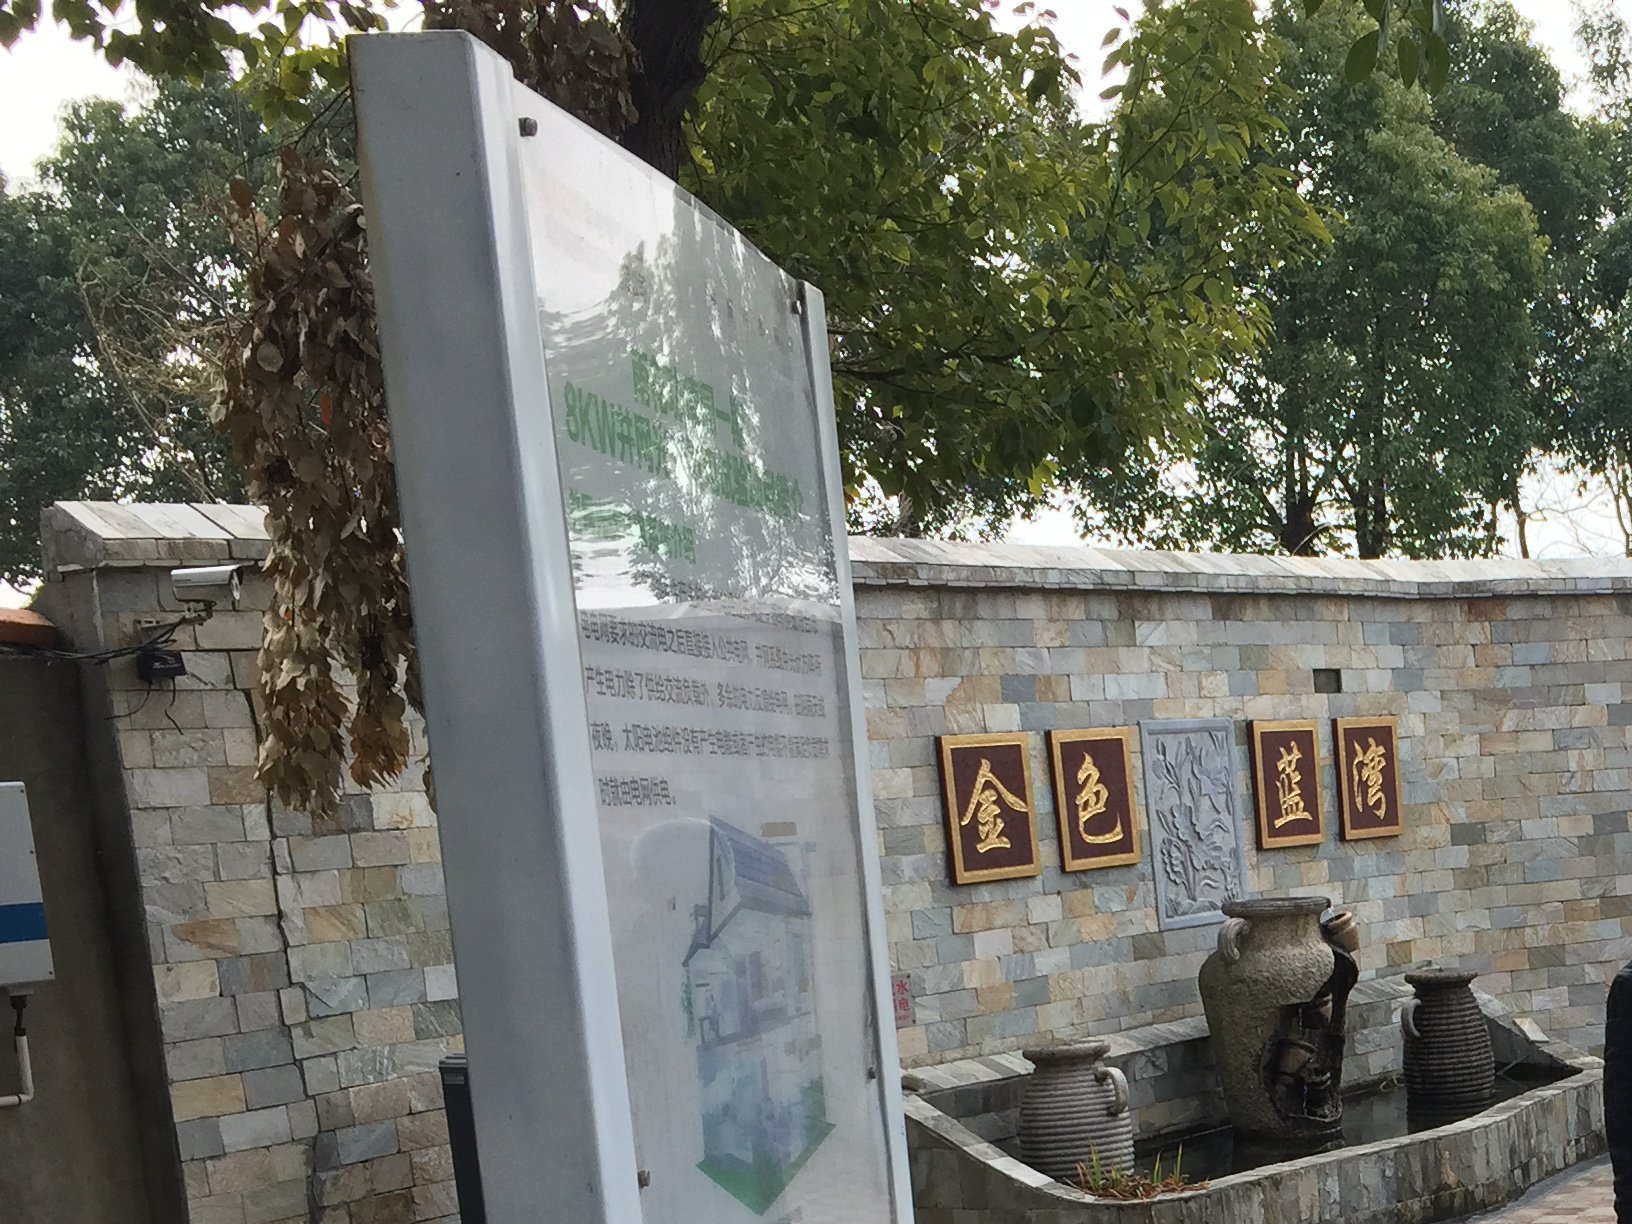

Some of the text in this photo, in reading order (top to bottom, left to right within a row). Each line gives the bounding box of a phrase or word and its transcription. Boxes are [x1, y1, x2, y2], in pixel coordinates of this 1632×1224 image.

[599, 777, 676, 808] 时就由电网供电。
[960, 735, 1387, 854] 金 色 蓝 湾
